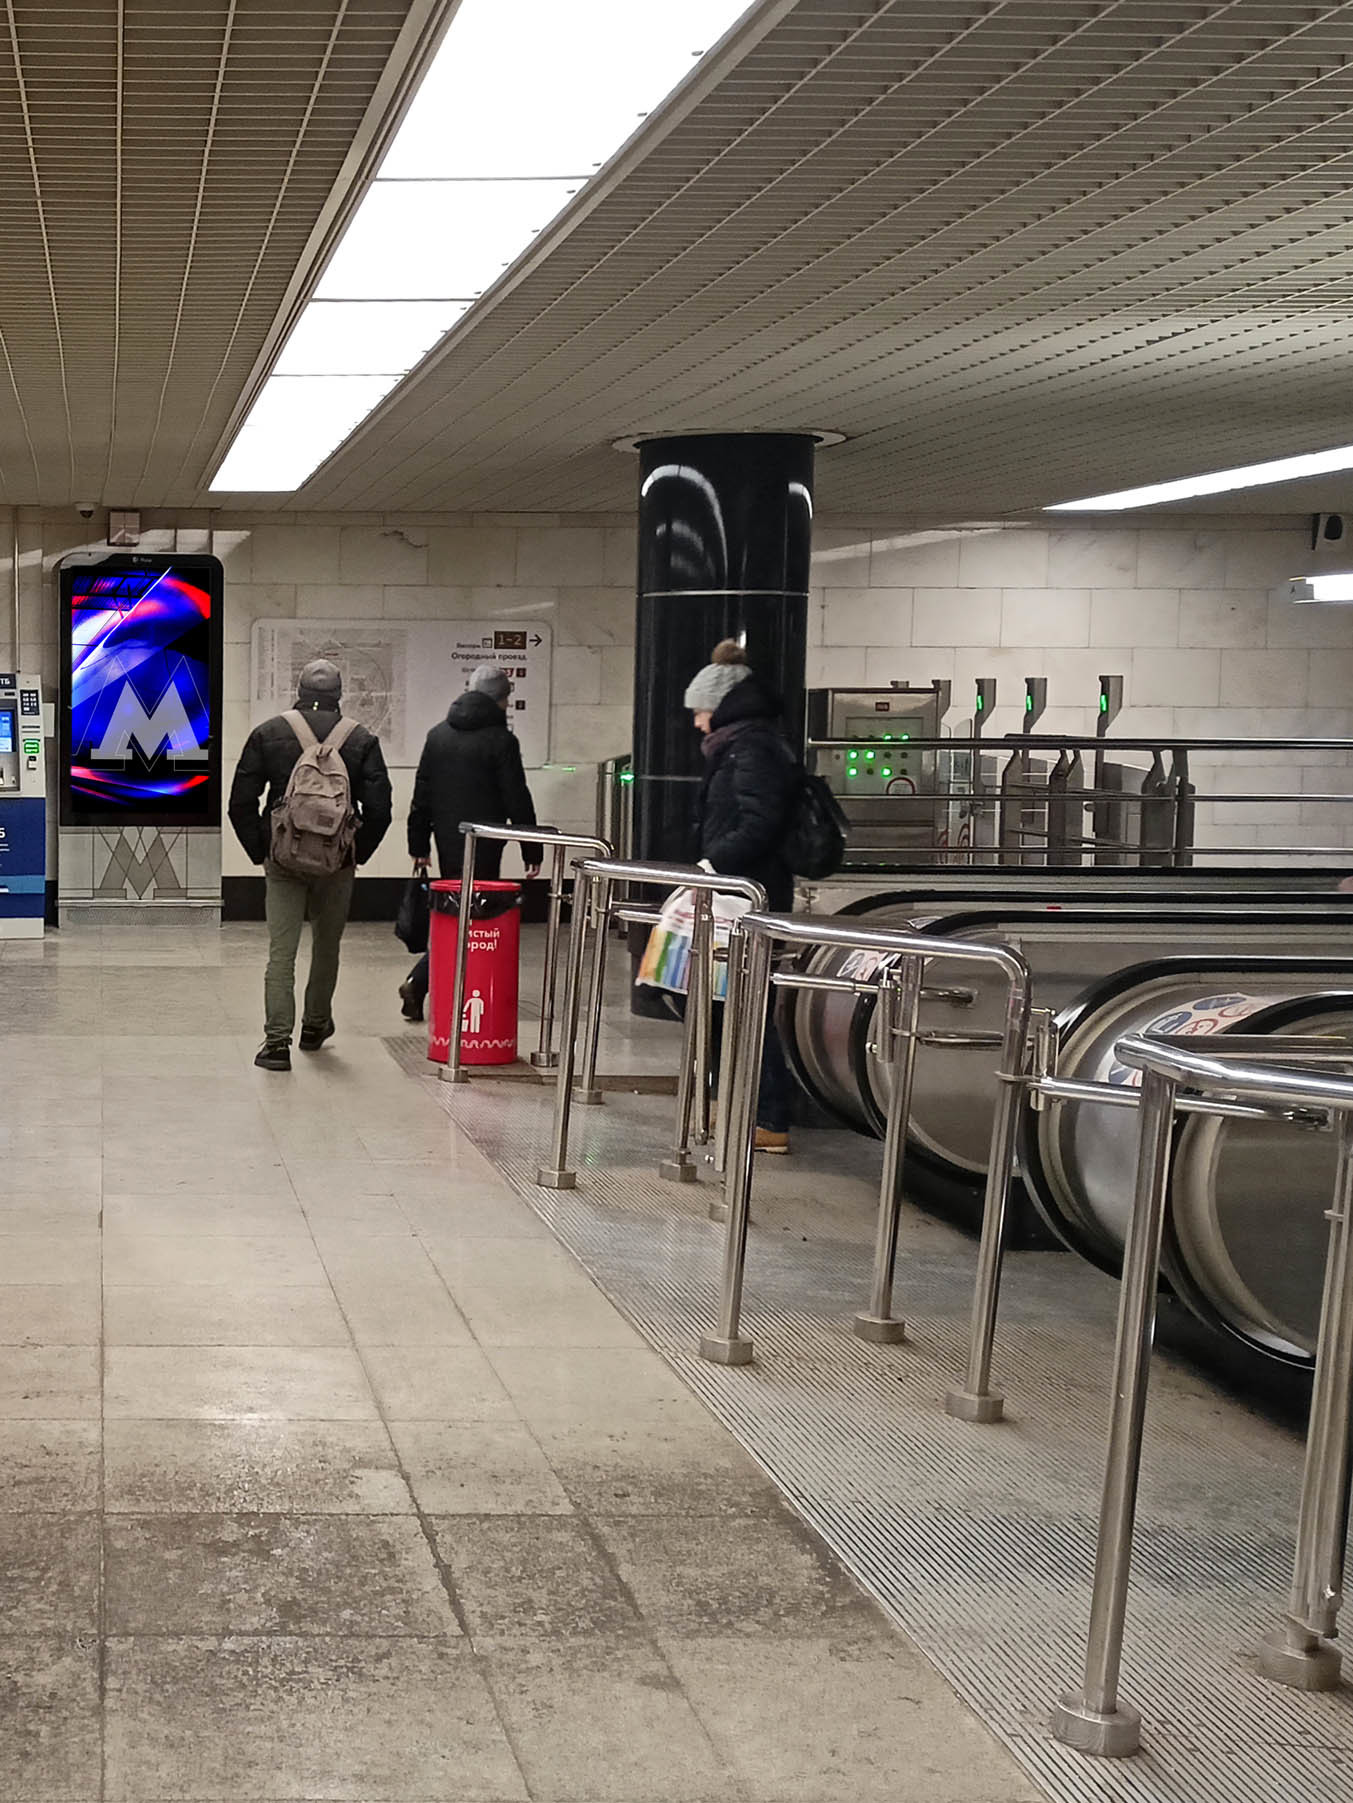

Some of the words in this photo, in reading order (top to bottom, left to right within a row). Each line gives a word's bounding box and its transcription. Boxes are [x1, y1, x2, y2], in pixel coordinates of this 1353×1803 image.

[451, 651, 497, 661] Огородный
[498, 653, 528, 662] проезд
[468, 927, 500, 938] истый
[467, 938, 497, 953] род!
